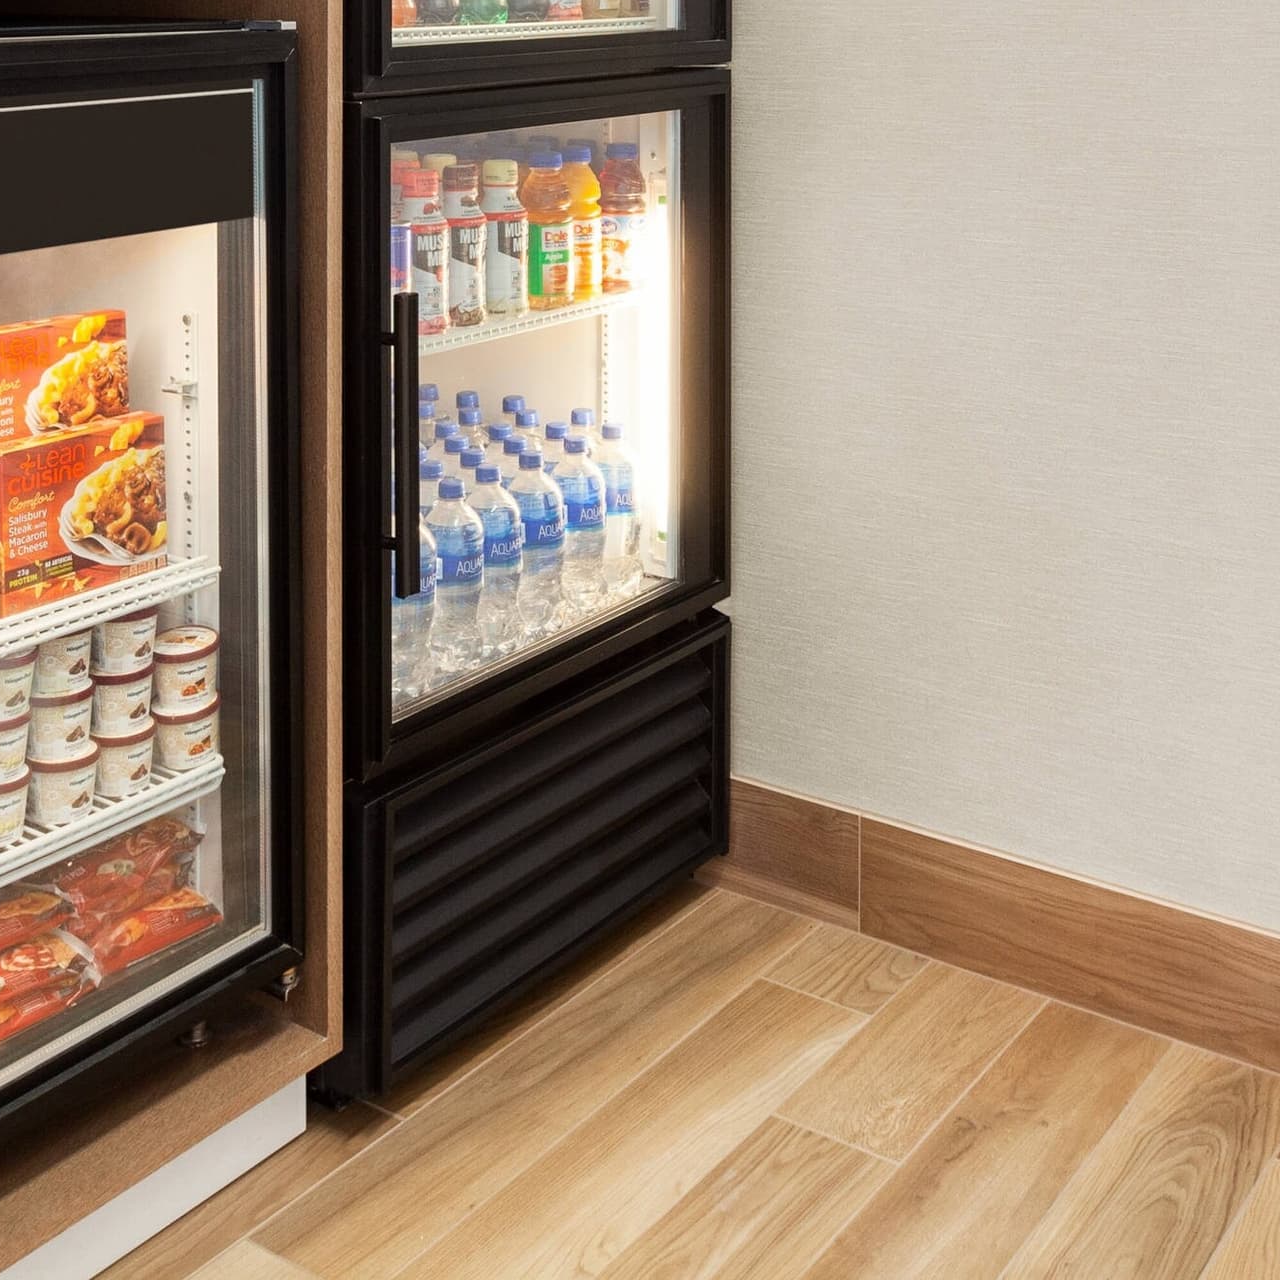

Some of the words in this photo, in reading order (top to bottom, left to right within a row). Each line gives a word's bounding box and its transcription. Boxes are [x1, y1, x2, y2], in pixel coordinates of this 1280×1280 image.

[544, 230, 569, 243] Dole
[36, 442, 86, 471] Lean
[7, 461, 86, 496] cuisine
[8, 489, 56, 513] Comfort
[8, 508, 48, 527] Salisbury
[8, 524, 33, 538] Steak
[8, 528, 48, 549] Macaroni
[17, 541, 49, 556] Cheese
[9, 573, 39, 589] PROTEIN
